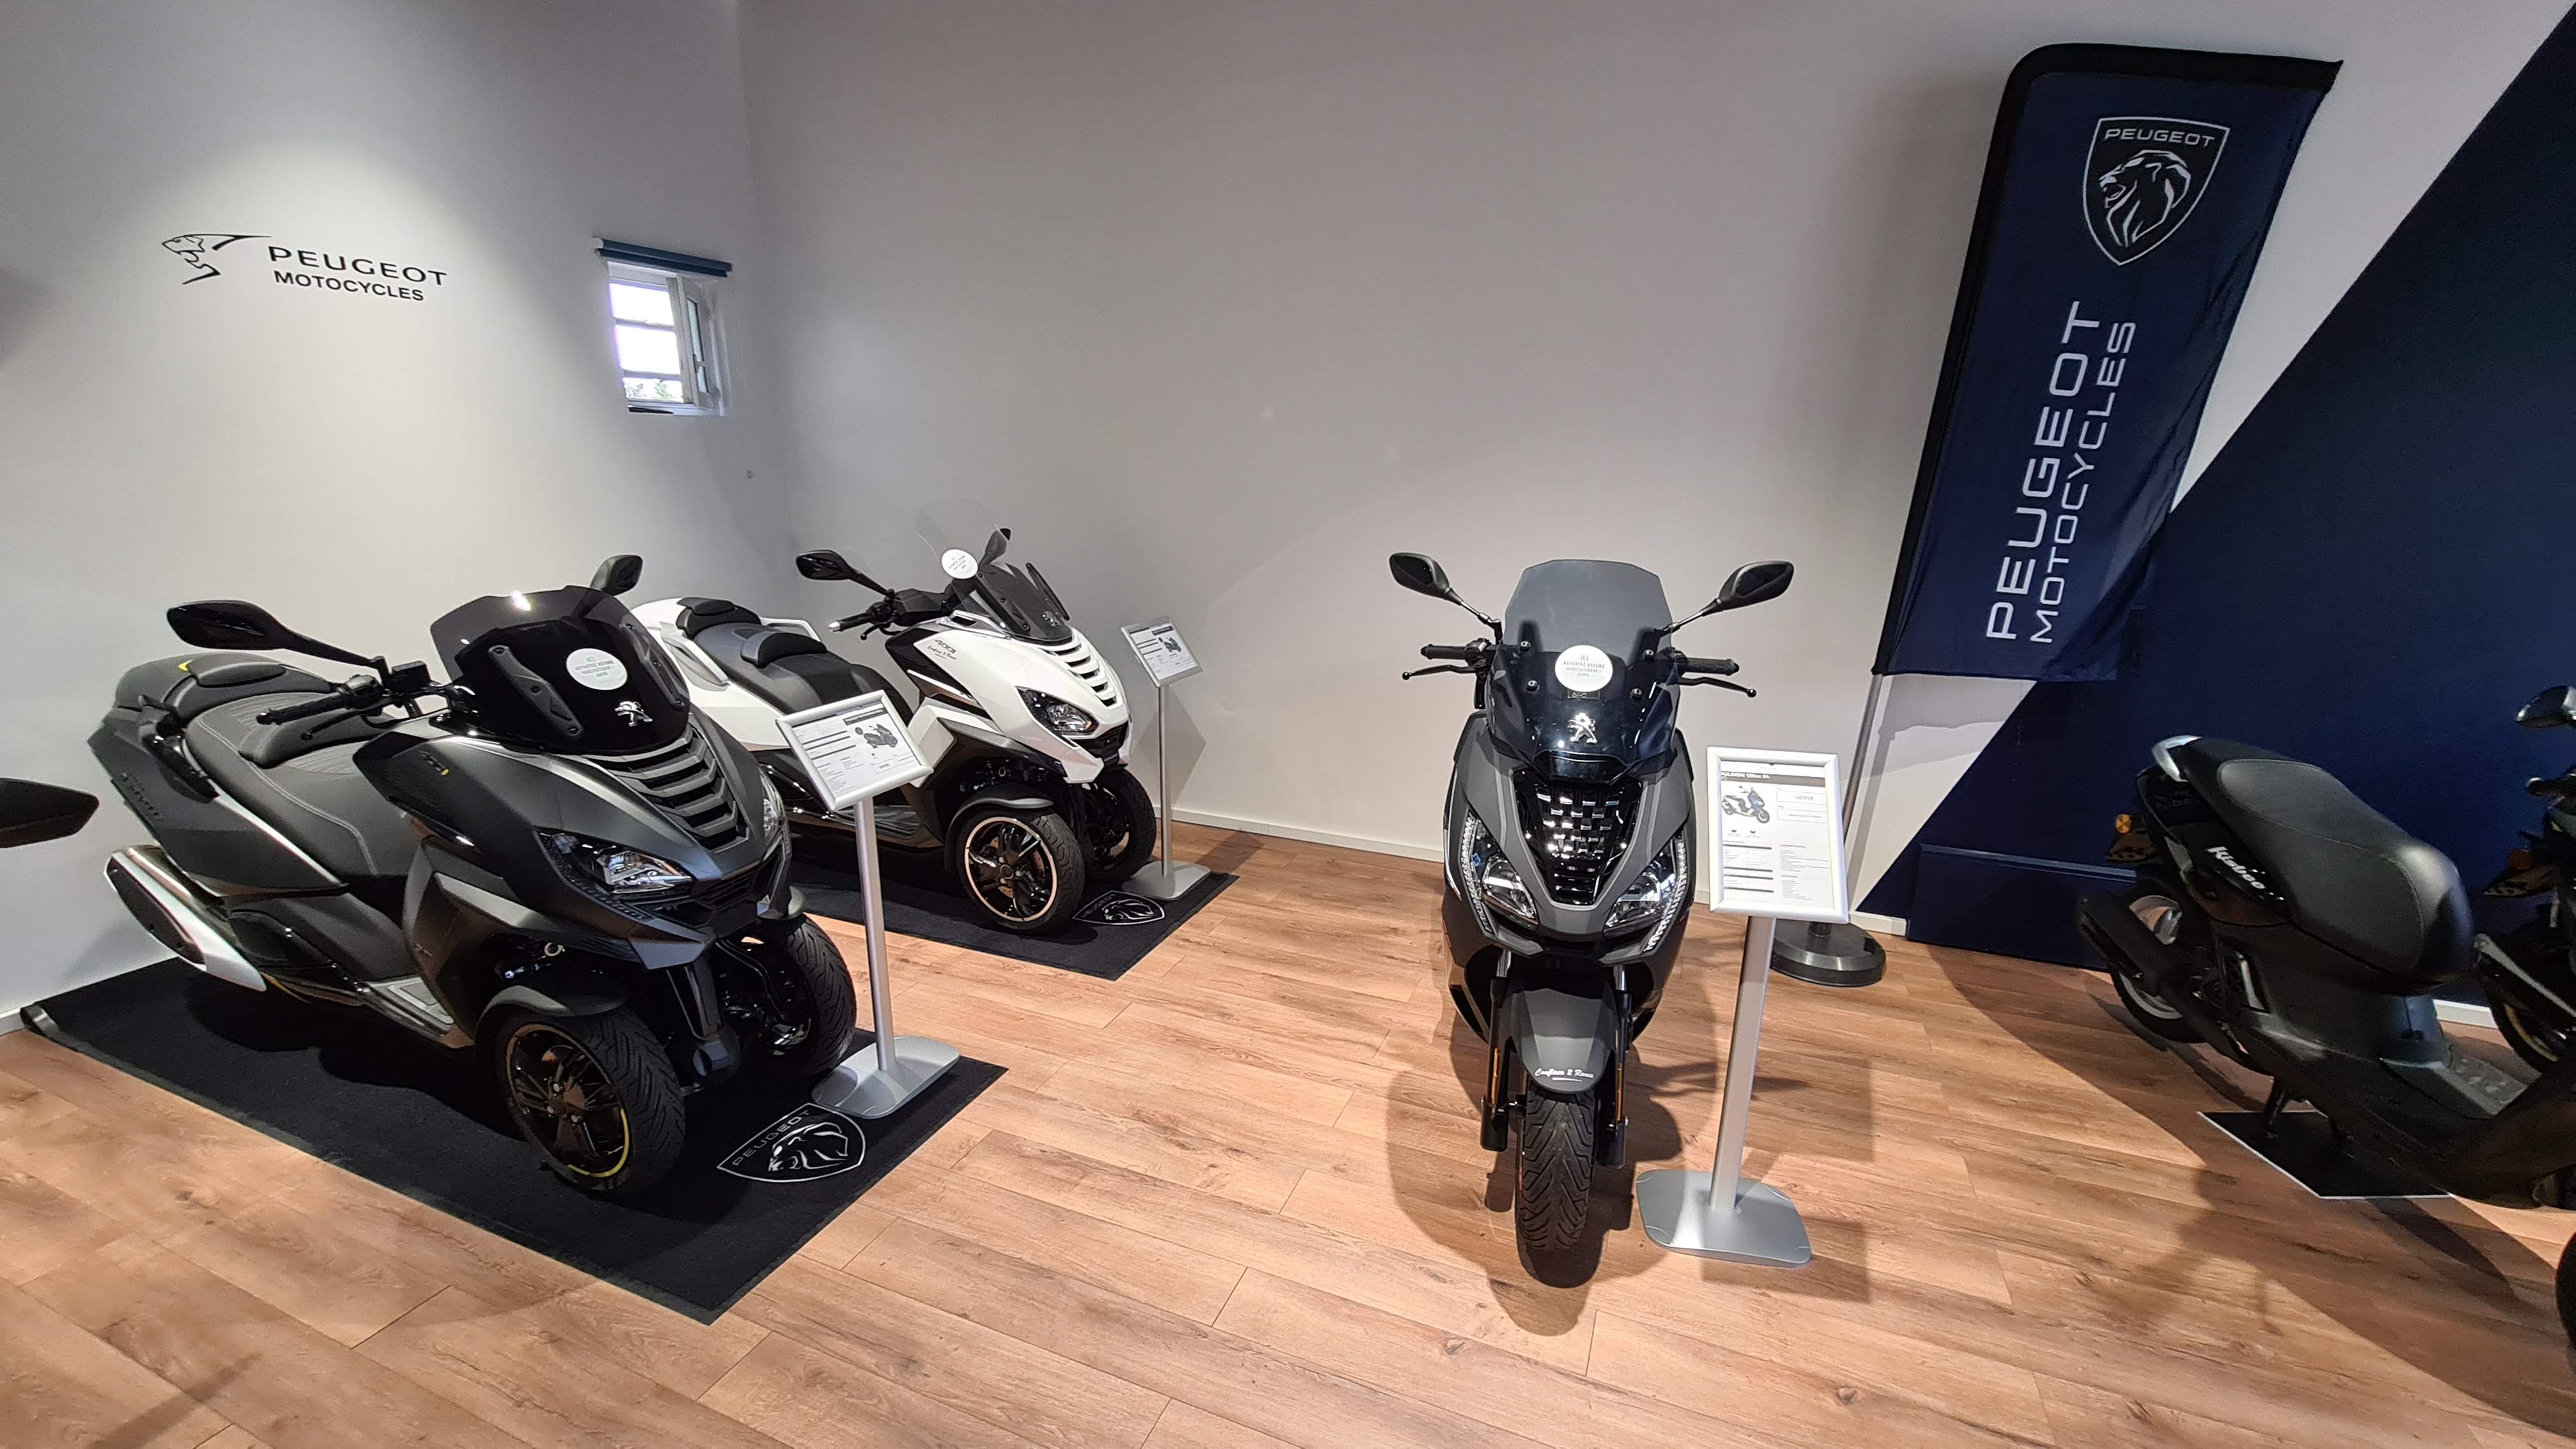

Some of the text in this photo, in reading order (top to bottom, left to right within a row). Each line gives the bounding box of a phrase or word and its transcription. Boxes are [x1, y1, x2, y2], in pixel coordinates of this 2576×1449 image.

[2104, 128, 2216, 148] PEUGEOT
[268, 245, 447, 286] PEUGEOT
[273, 270, 424, 301] MOTOCYCLES
[1986, 301, 2101, 641] PEUGEOT
[2030, 321, 2136, 644] MOTOCYCLES
[732, 1110, 809, 1166] PEUGEOT
